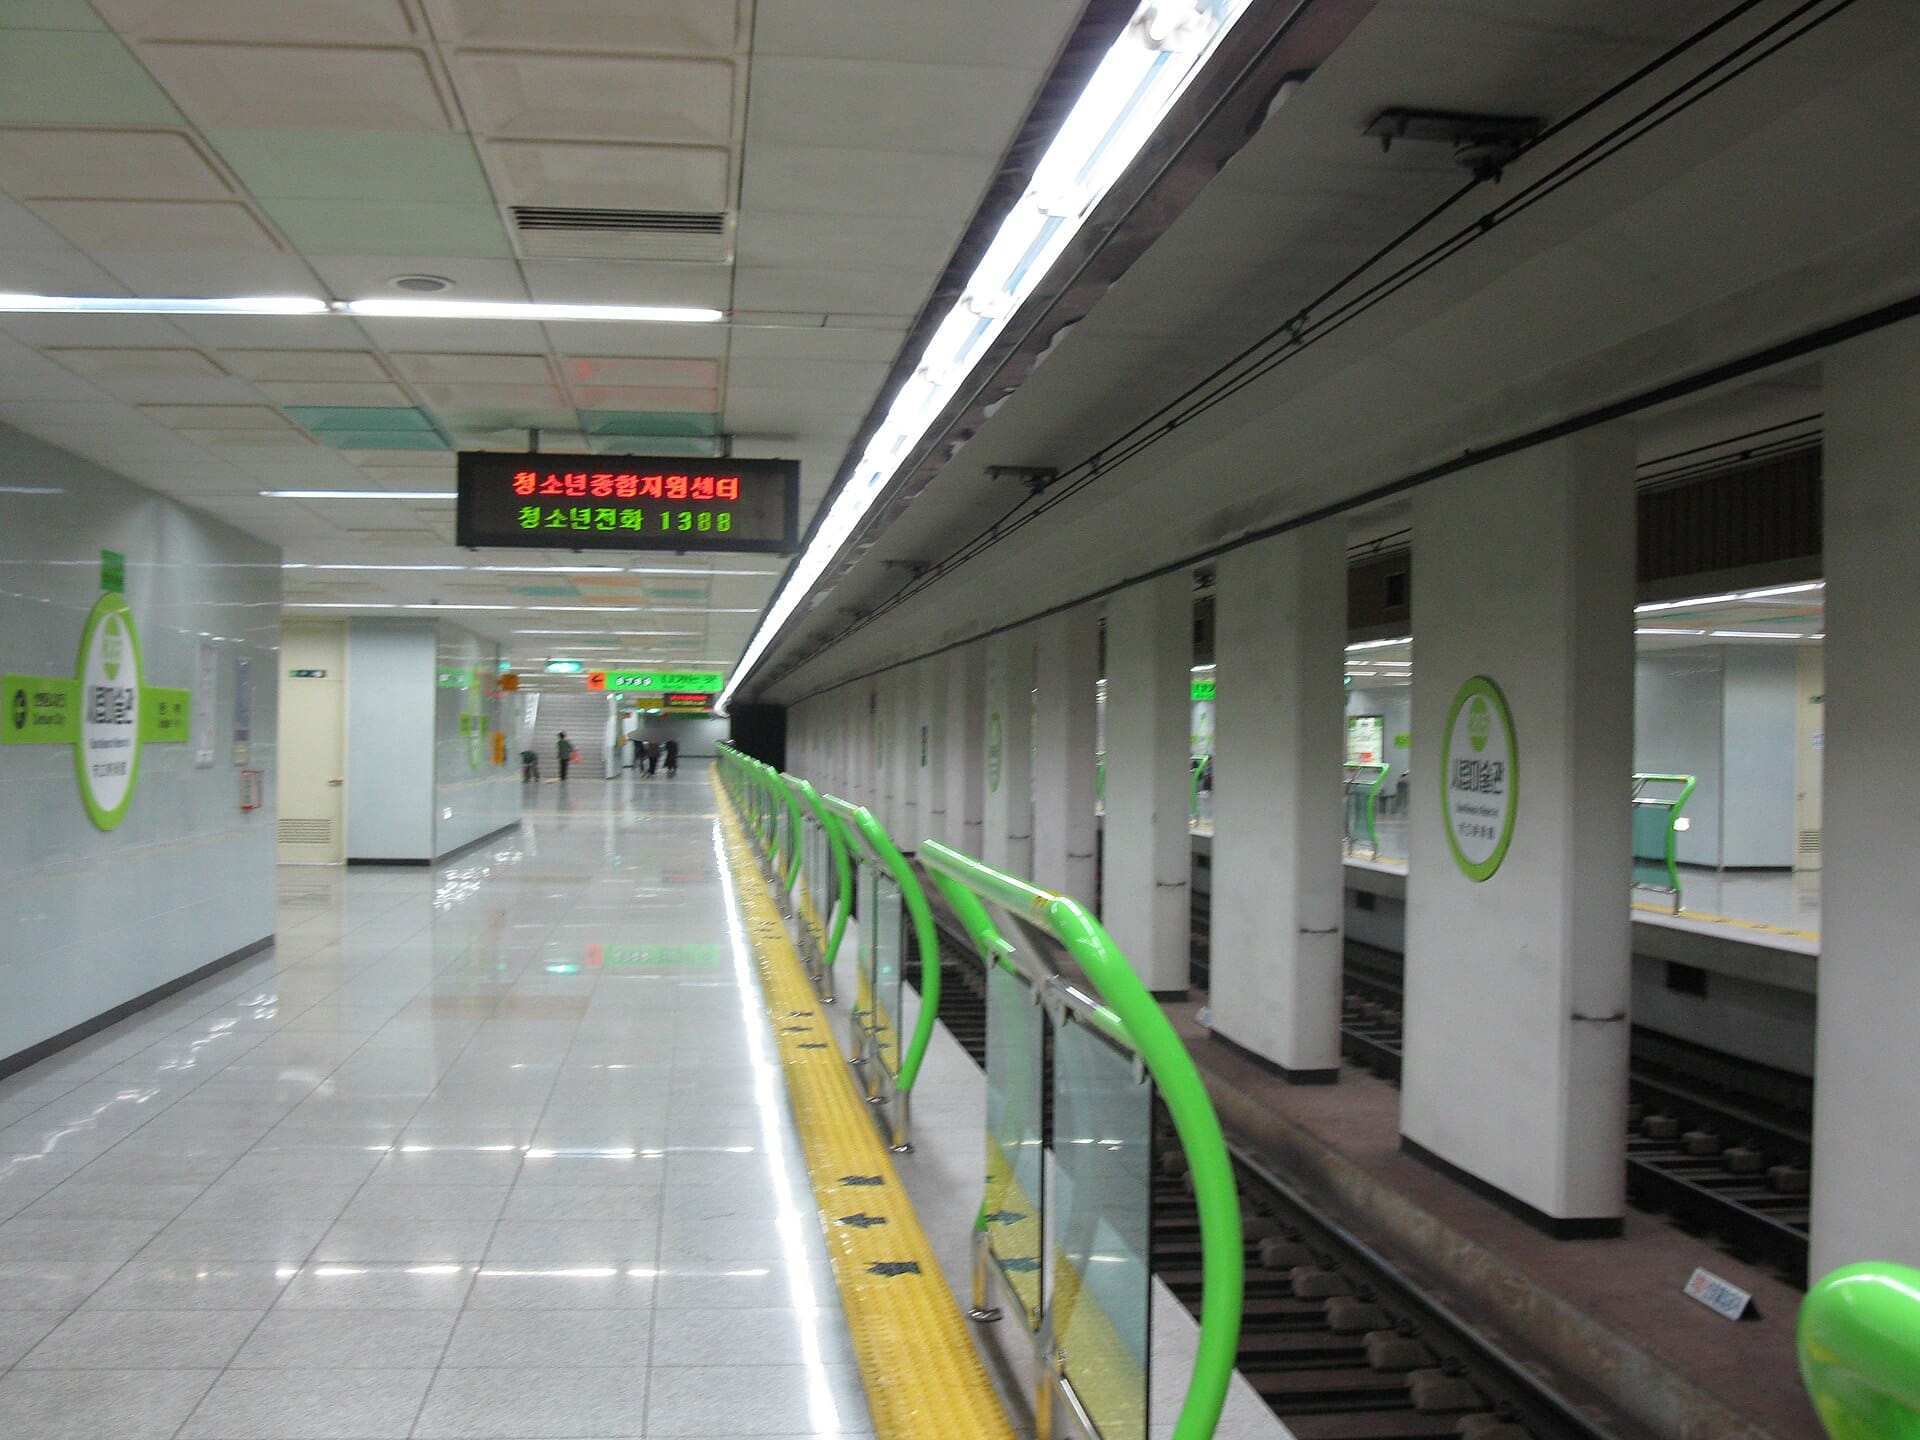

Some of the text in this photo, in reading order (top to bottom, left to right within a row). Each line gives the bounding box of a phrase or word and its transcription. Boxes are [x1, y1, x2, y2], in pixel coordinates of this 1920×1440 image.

[512, 471, 739, 500] 청소년종합지원센터
[517, 506, 732, 532] 청소년전화 1388
